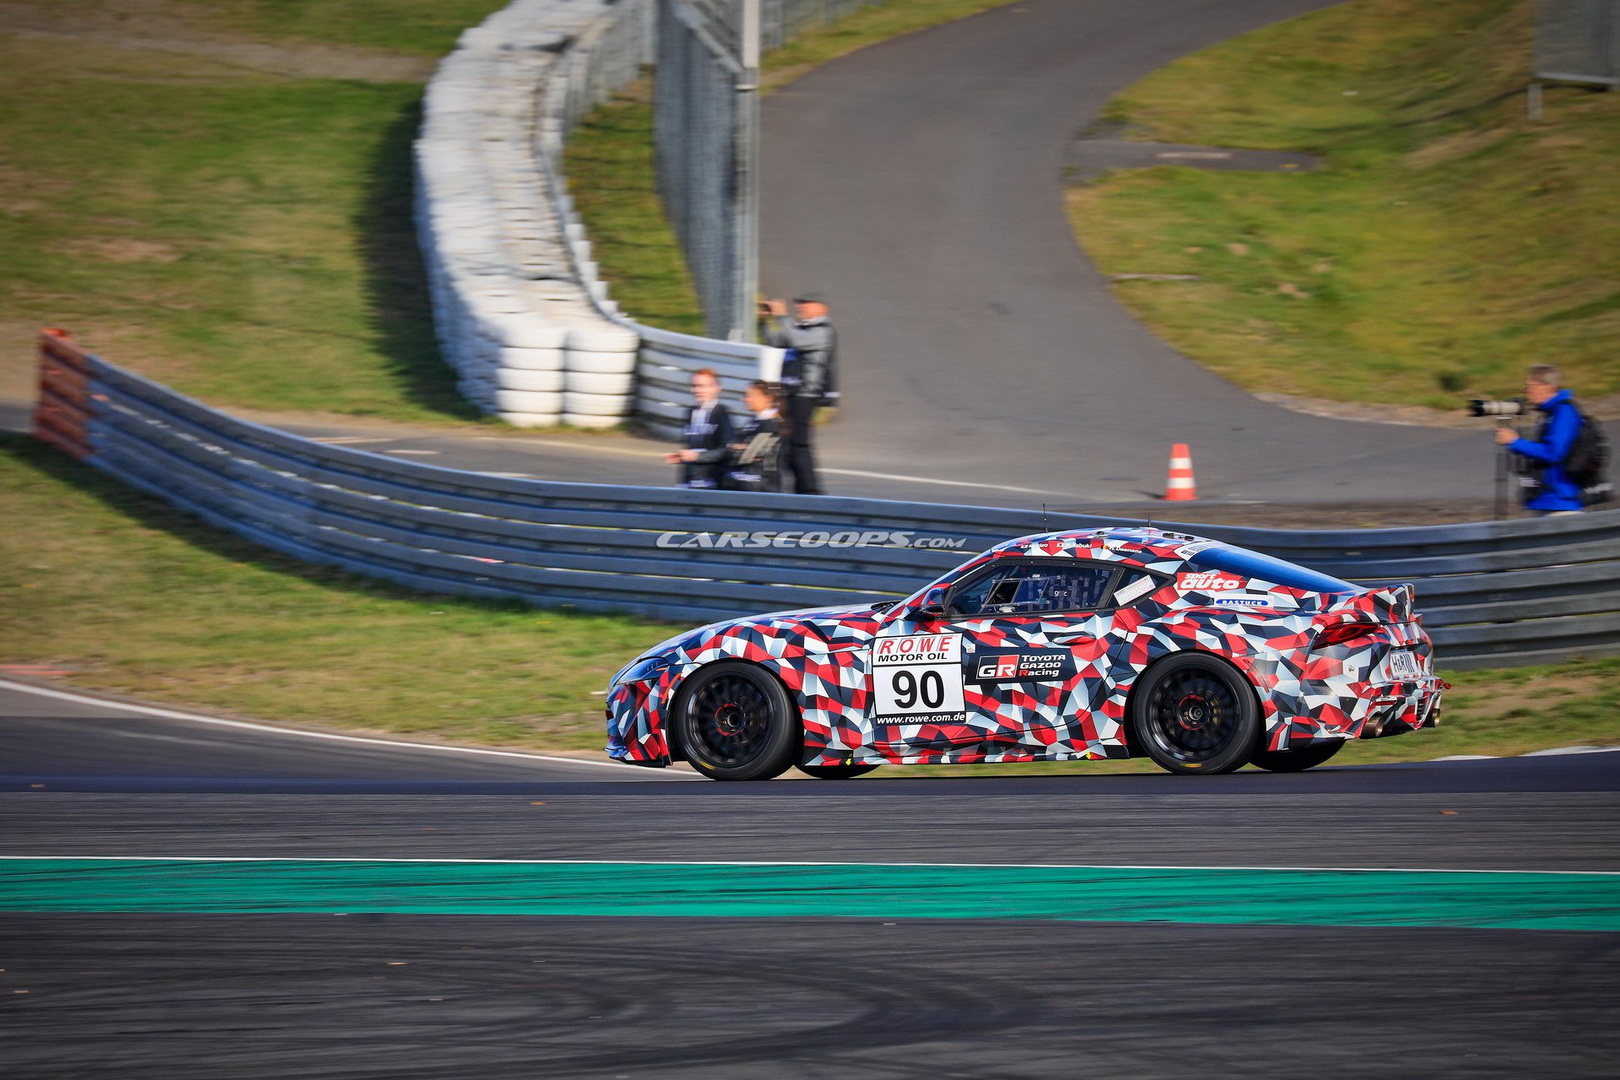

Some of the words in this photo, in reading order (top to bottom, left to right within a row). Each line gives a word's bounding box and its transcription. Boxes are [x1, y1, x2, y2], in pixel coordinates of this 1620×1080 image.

[1180, 578, 1240, 589] auto
[878, 636, 953, 654] ROWE
[878, 654, 923, 662] MOTOR
[1021, 654, 1066, 662] TOYOTA
[978, 664, 1016, 677] GR
[1018, 669, 1060, 677] Racing
[892, 670, 945, 709] 90
[877, 713, 965, 724] www.rowe.com.de
